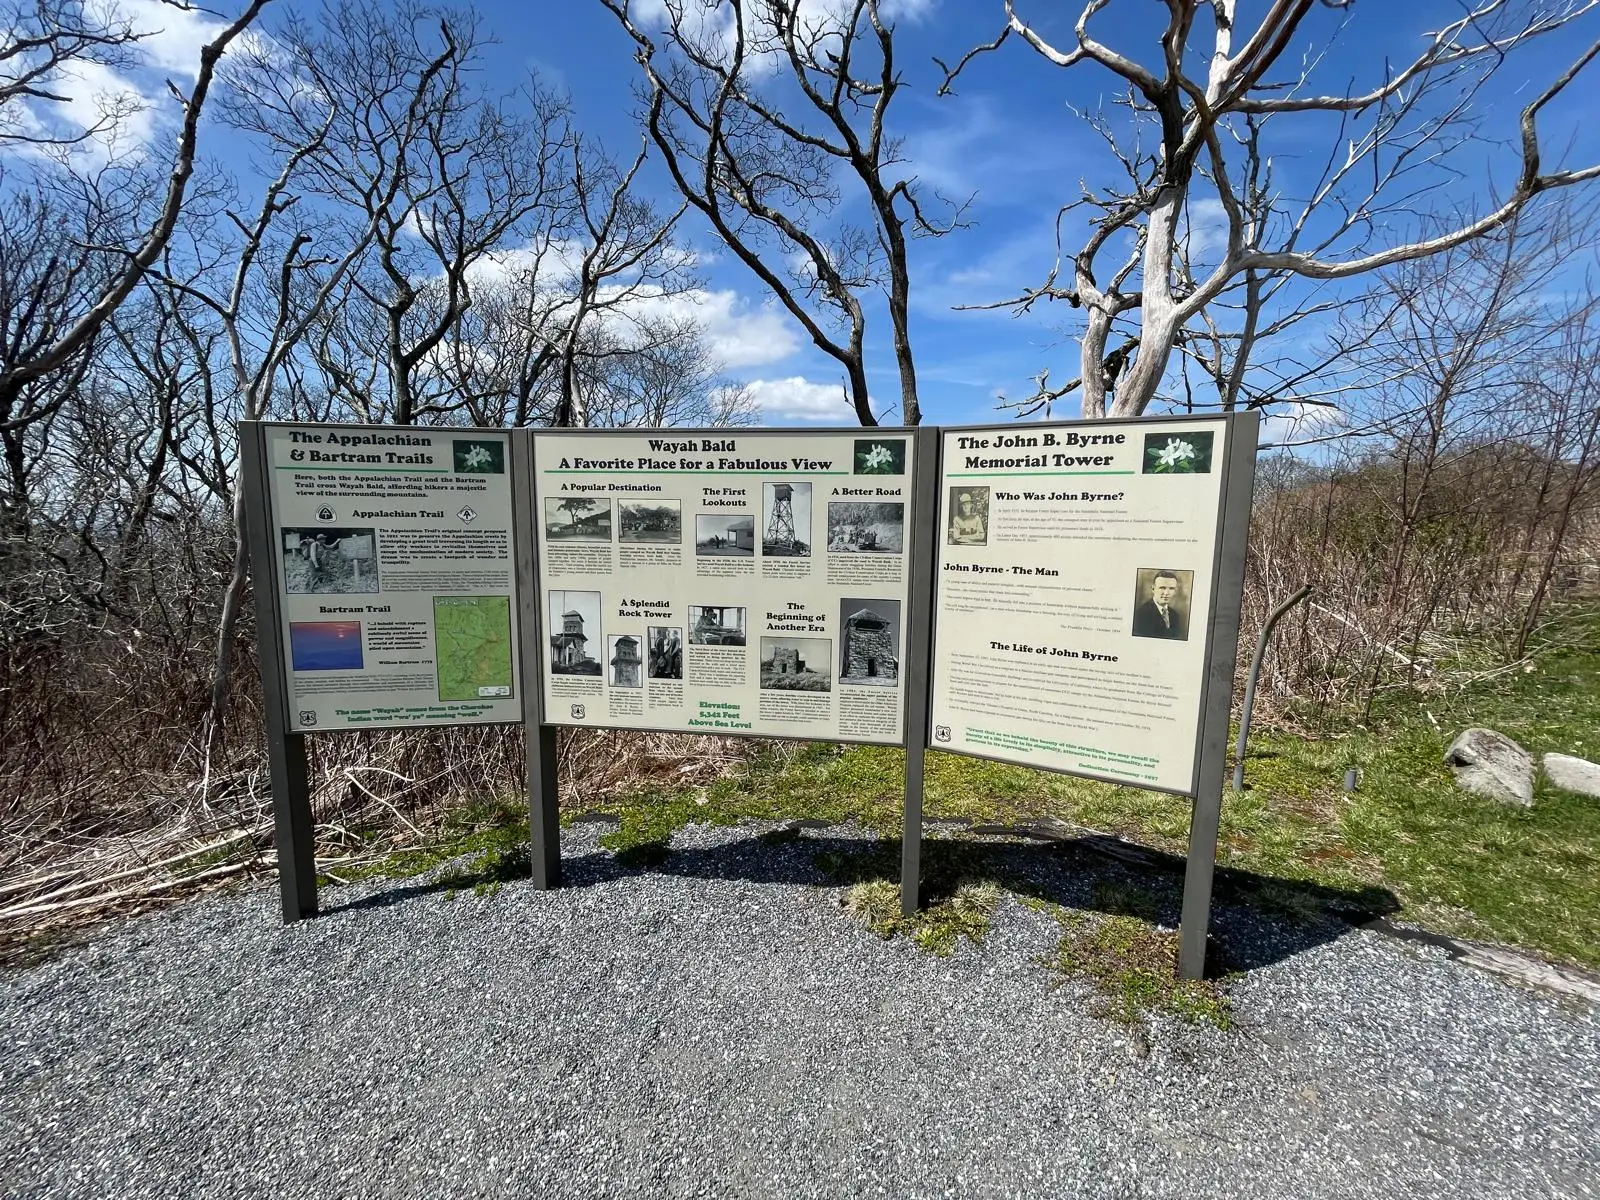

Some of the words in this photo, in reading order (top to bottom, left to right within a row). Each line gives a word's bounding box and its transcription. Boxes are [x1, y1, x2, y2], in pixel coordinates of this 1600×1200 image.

[289, 431, 322, 443] The
[326, 433, 432, 446] Appalachian
[958, 437, 989, 449] The
[993, 435, 1038, 448] John
[1043, 434, 1060, 446] B.
[1066, 433, 1125, 447] Byrne
[648, 440, 698, 454] Wayah
[702, 440, 736, 452] Bald
[290, 449, 305, 461] &
[309, 450, 381, 463] Bartram
[385, 452, 433, 464] Trails
[965, 455, 1047, 468] Memorial
[1052, 454, 1114, 466] Tower
[559, 458, 570, 468] A
[574, 458, 634, 469] Favorite
[638, 458, 676, 469] Place
[680, 458, 702, 469] for
[706, 461, 714, 469] a
[718, 459, 787, 470] Fabulous
[791, 459, 832, 470] View
[570, 484, 606, 492] Popular
[1081, 492, 1124, 502] Byrne?
[944, 563, 969, 571] John
[972, 565, 1004, 573] Byrne
[1035, 568, 1058, 576] Man
[630, 600, 670, 608] Splendid
[767, 613, 814, 622] Beginning
[990, 642, 1010, 650] The
[1013, 644, 1033, 653] Life
[1049, 648, 1078, 658] John
[1082, 651, 1118, 662] Byrne
